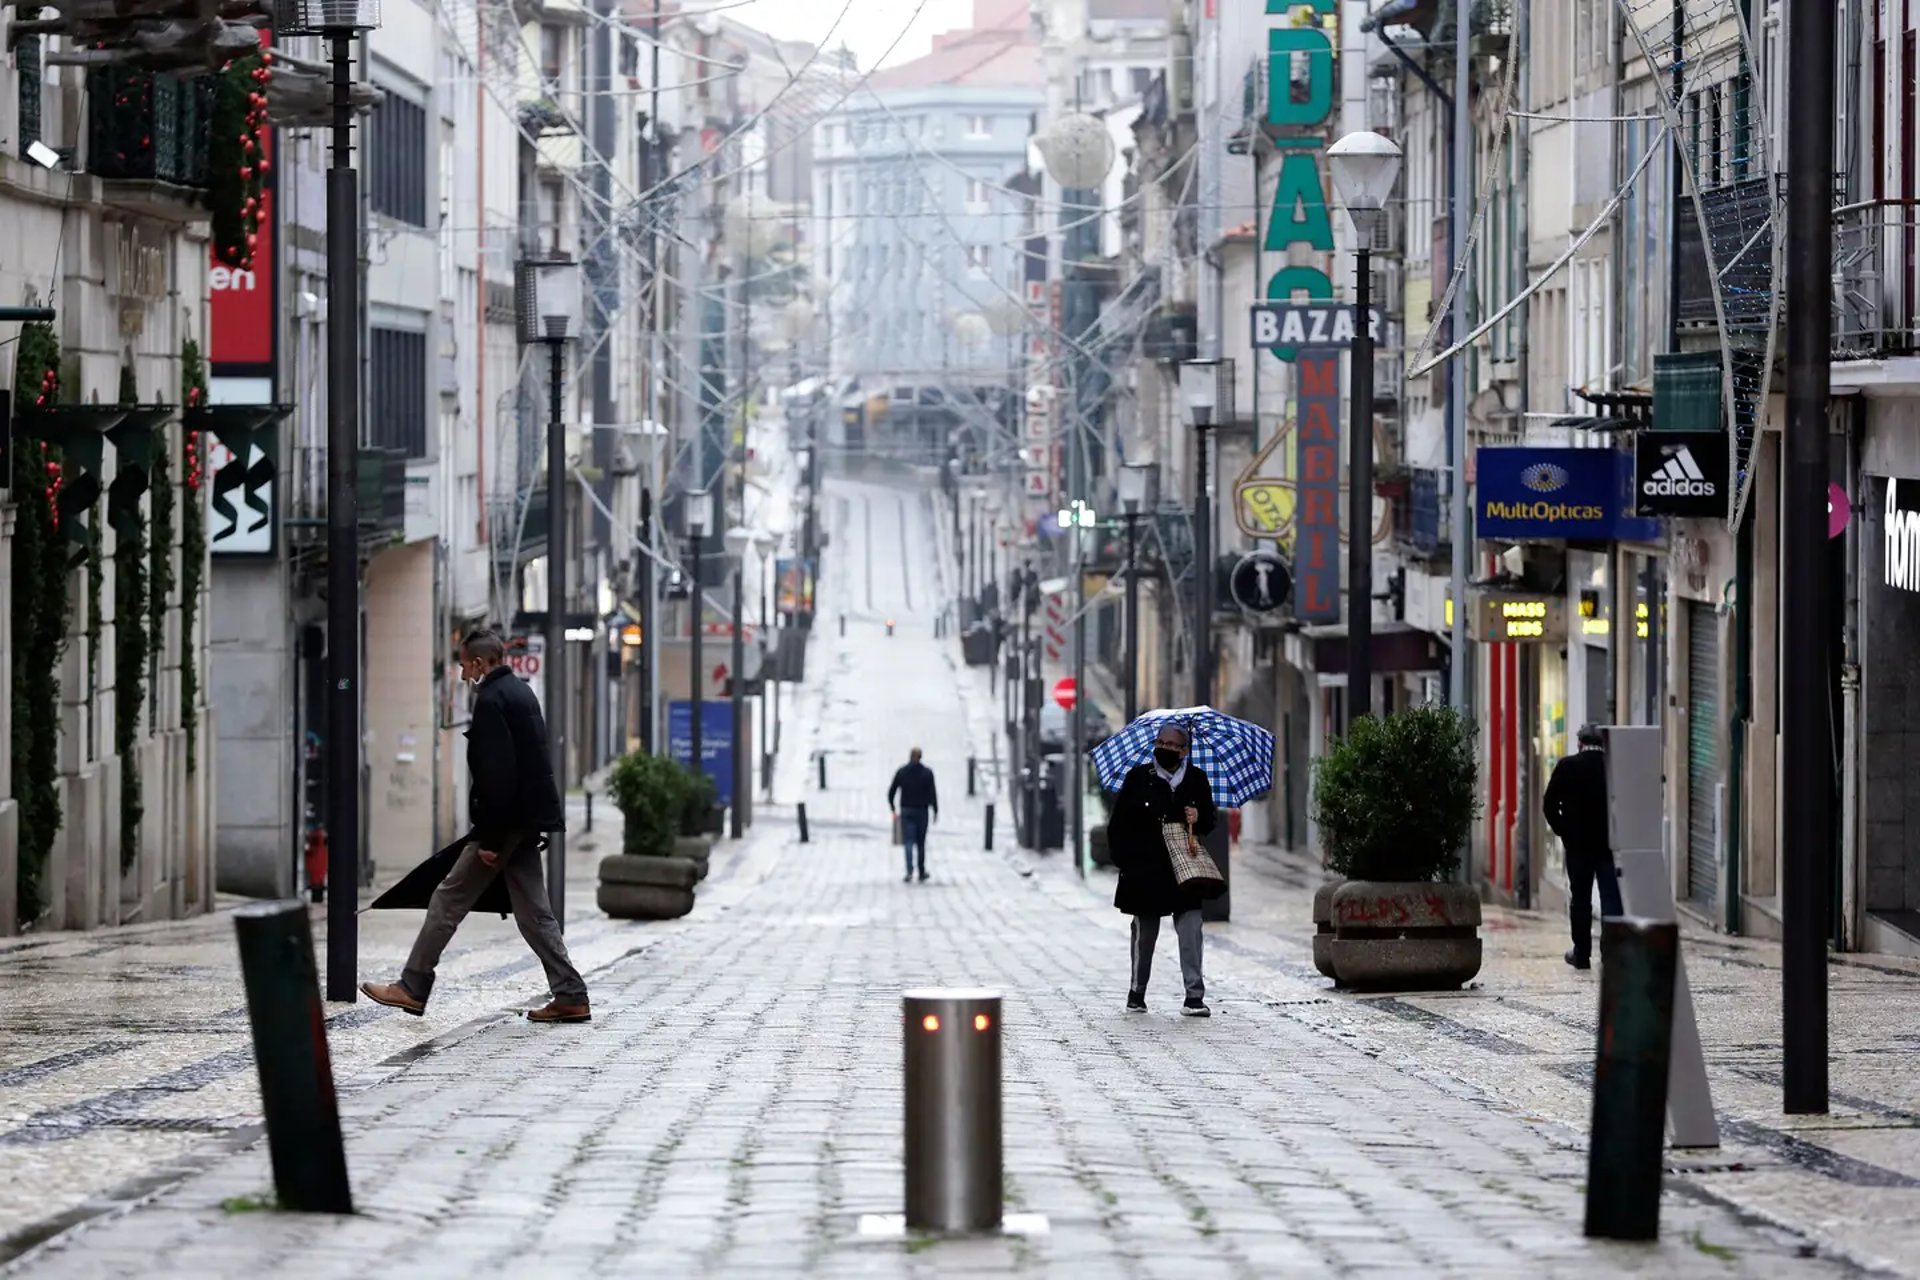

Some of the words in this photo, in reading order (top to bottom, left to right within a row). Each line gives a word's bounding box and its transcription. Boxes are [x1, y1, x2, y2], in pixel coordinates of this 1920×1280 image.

[1255, 309, 1382, 343] BAZAR
[1301, 359, 1337, 611] MABRIL
[1643, 477, 1716, 496] adidas
[1486, 501, 1603, 522] MultiOpticas
[1884, 476, 1920, 592] hom
[1502, 602, 1546, 618] MASS
